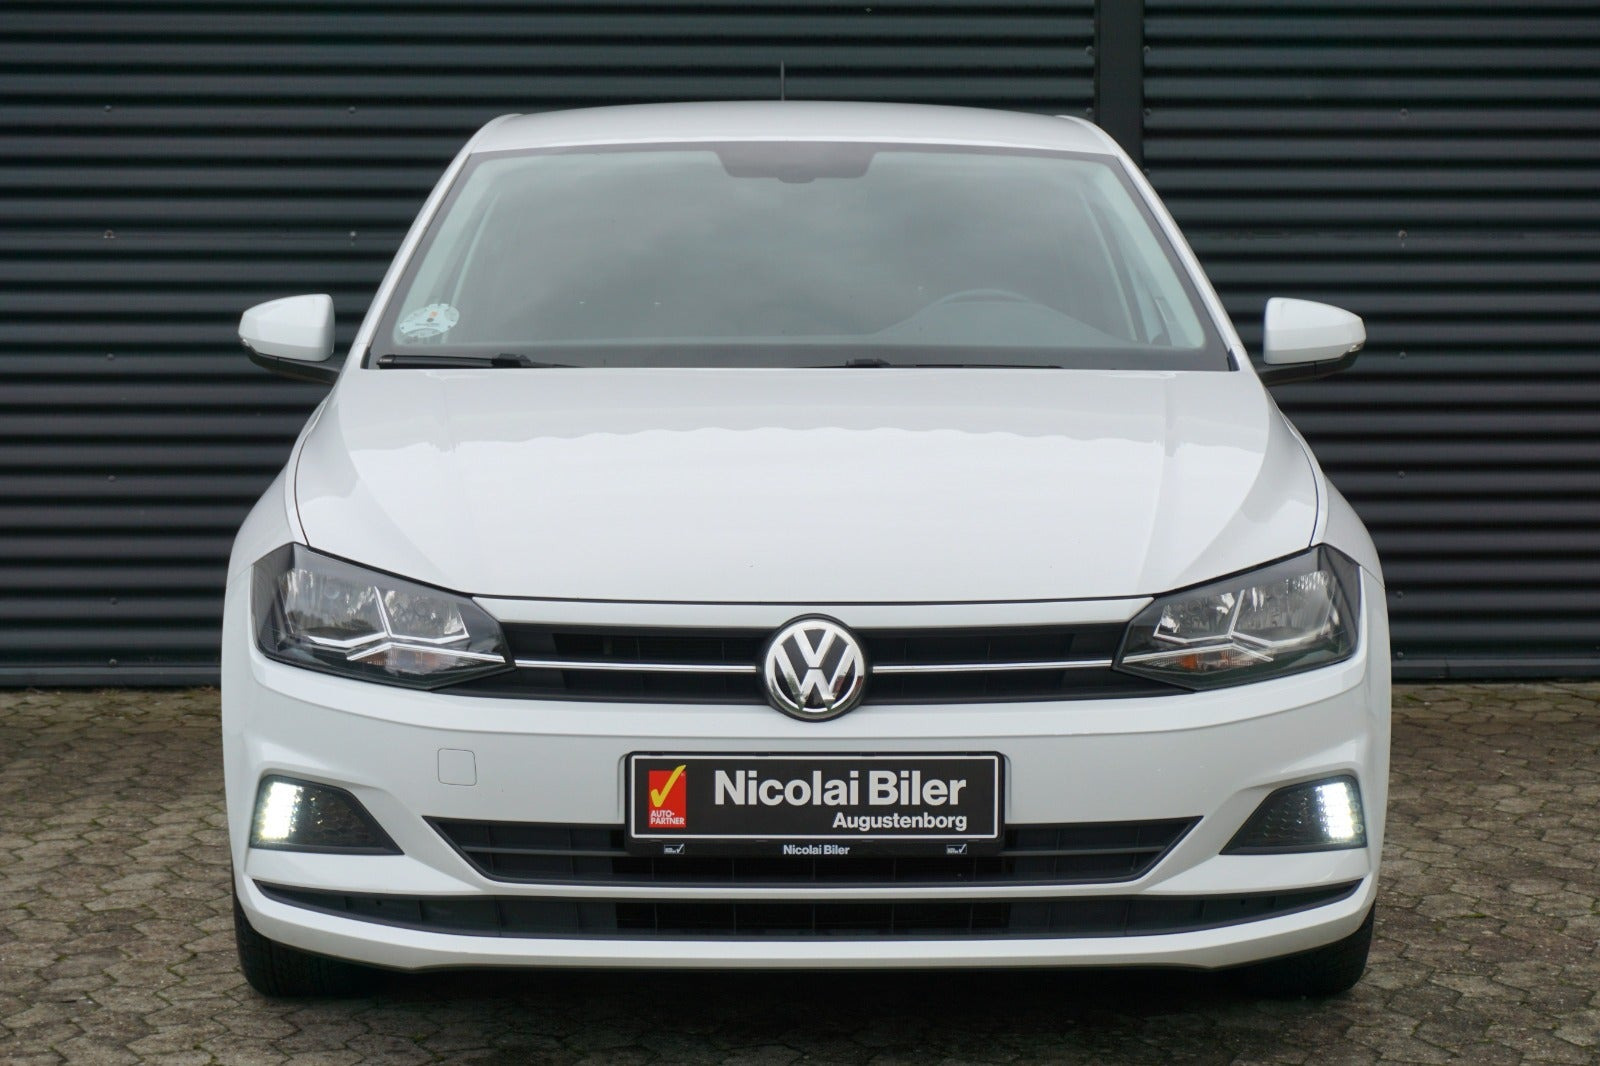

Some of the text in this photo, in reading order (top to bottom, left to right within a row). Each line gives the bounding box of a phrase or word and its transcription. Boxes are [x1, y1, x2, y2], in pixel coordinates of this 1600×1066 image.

[767, 620, 862, 714] VW
[714, 769, 967, 806] Nicolai Biler
[650, 817, 685, 825] PARTNER
[832, 811, 968, 832] Augustenborg
[783, 844, 850, 855] Nicolai Biler
